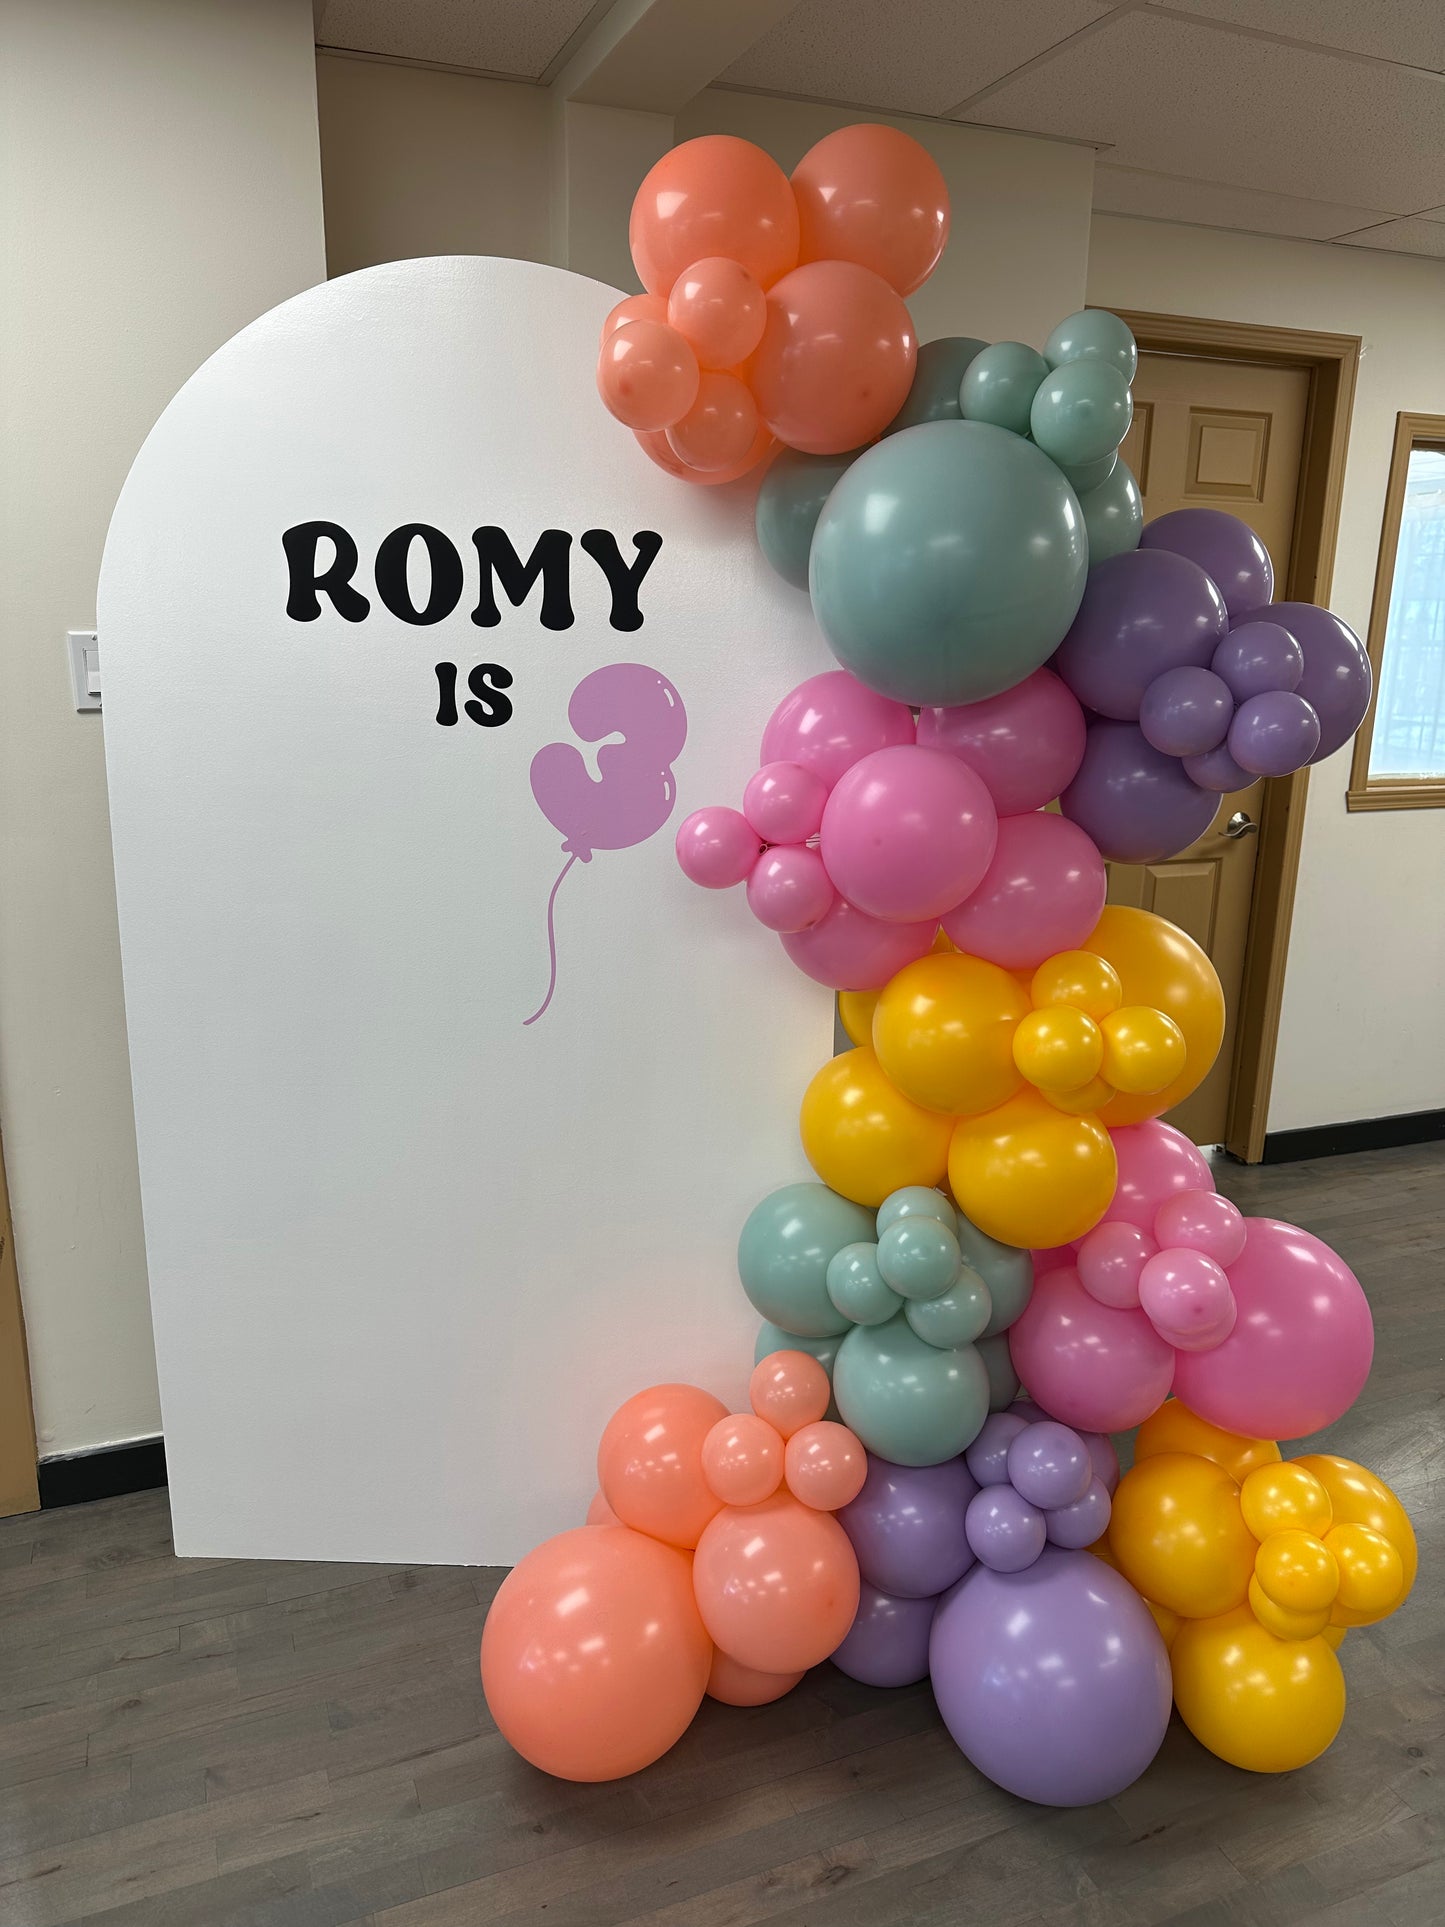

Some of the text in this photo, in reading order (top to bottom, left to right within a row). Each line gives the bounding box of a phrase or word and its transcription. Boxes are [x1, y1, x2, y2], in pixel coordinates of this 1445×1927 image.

[282, 521, 663, 632] ROMY
[434, 662, 688, 862] IS 3
